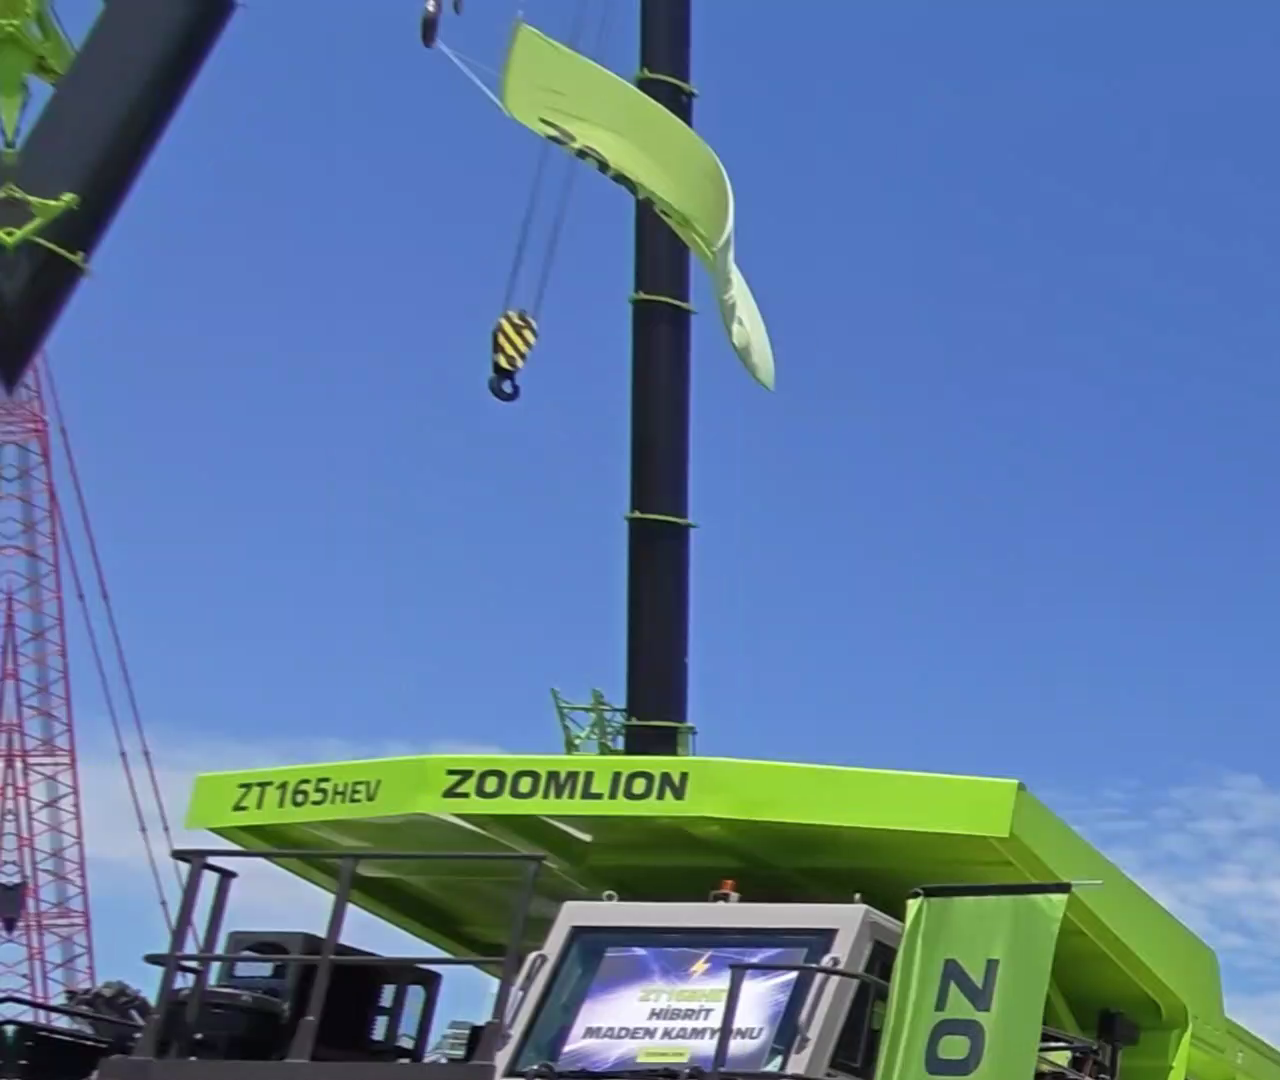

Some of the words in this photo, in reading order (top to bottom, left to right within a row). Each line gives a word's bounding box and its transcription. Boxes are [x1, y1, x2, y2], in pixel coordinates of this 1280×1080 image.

[231, 777, 382, 812] ZT165HEV
[441, 768, 690, 801] ZOOMLION
[580, 1026, 659, 1041] MADEN
[659, 1026, 765, 1041] KAMYNU
